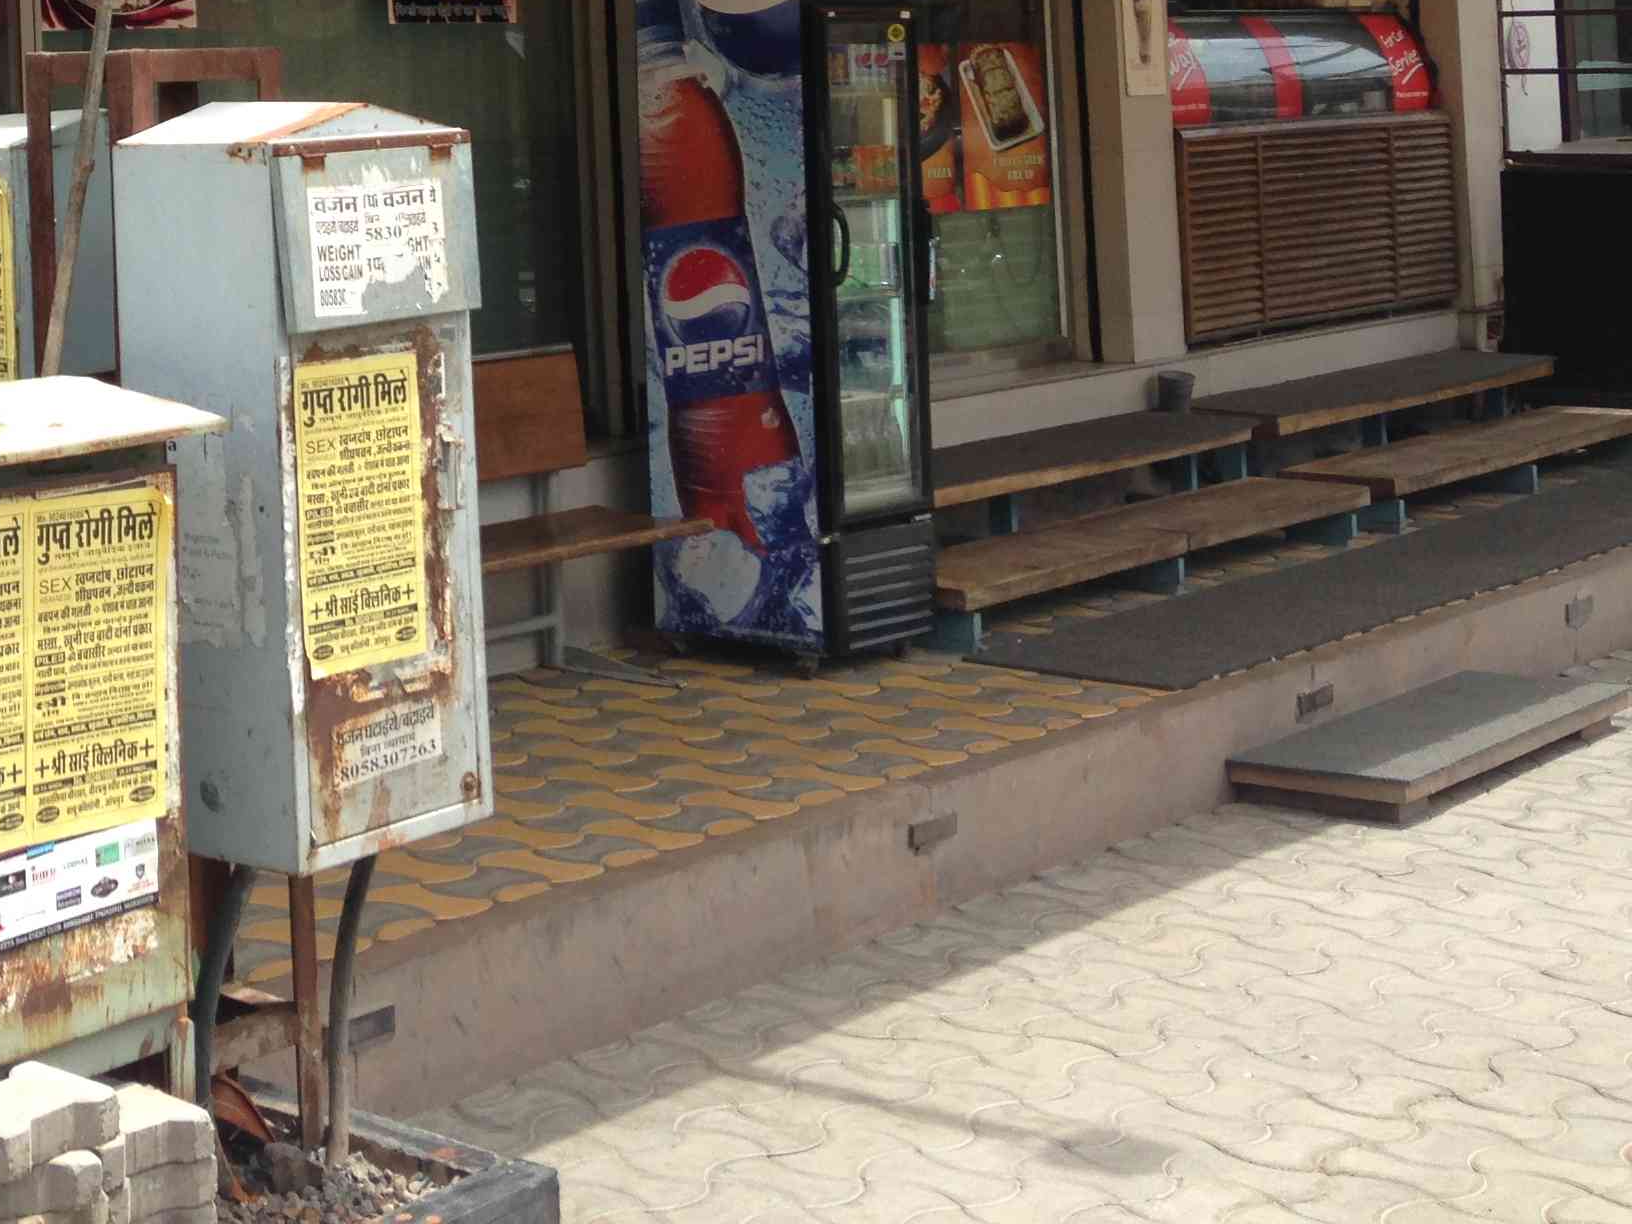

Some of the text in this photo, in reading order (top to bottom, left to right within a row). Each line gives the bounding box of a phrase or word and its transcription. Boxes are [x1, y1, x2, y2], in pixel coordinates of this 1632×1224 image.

[312, 196, 358, 213] वजन
[317, 244, 362, 262] WEIGHT
[319, 264, 363, 282] LOSS GAIN
[665, 334, 764, 376] PEPSI
[336, 376, 371, 412] रोगी
[305, 439, 336, 455] SEX
[76, 508, 114, 548] रोगी
[39, 578, 72, 595] SEX
[51, 749, 66, 775] श्री
[340, 739, 436, 782] 8058307263
